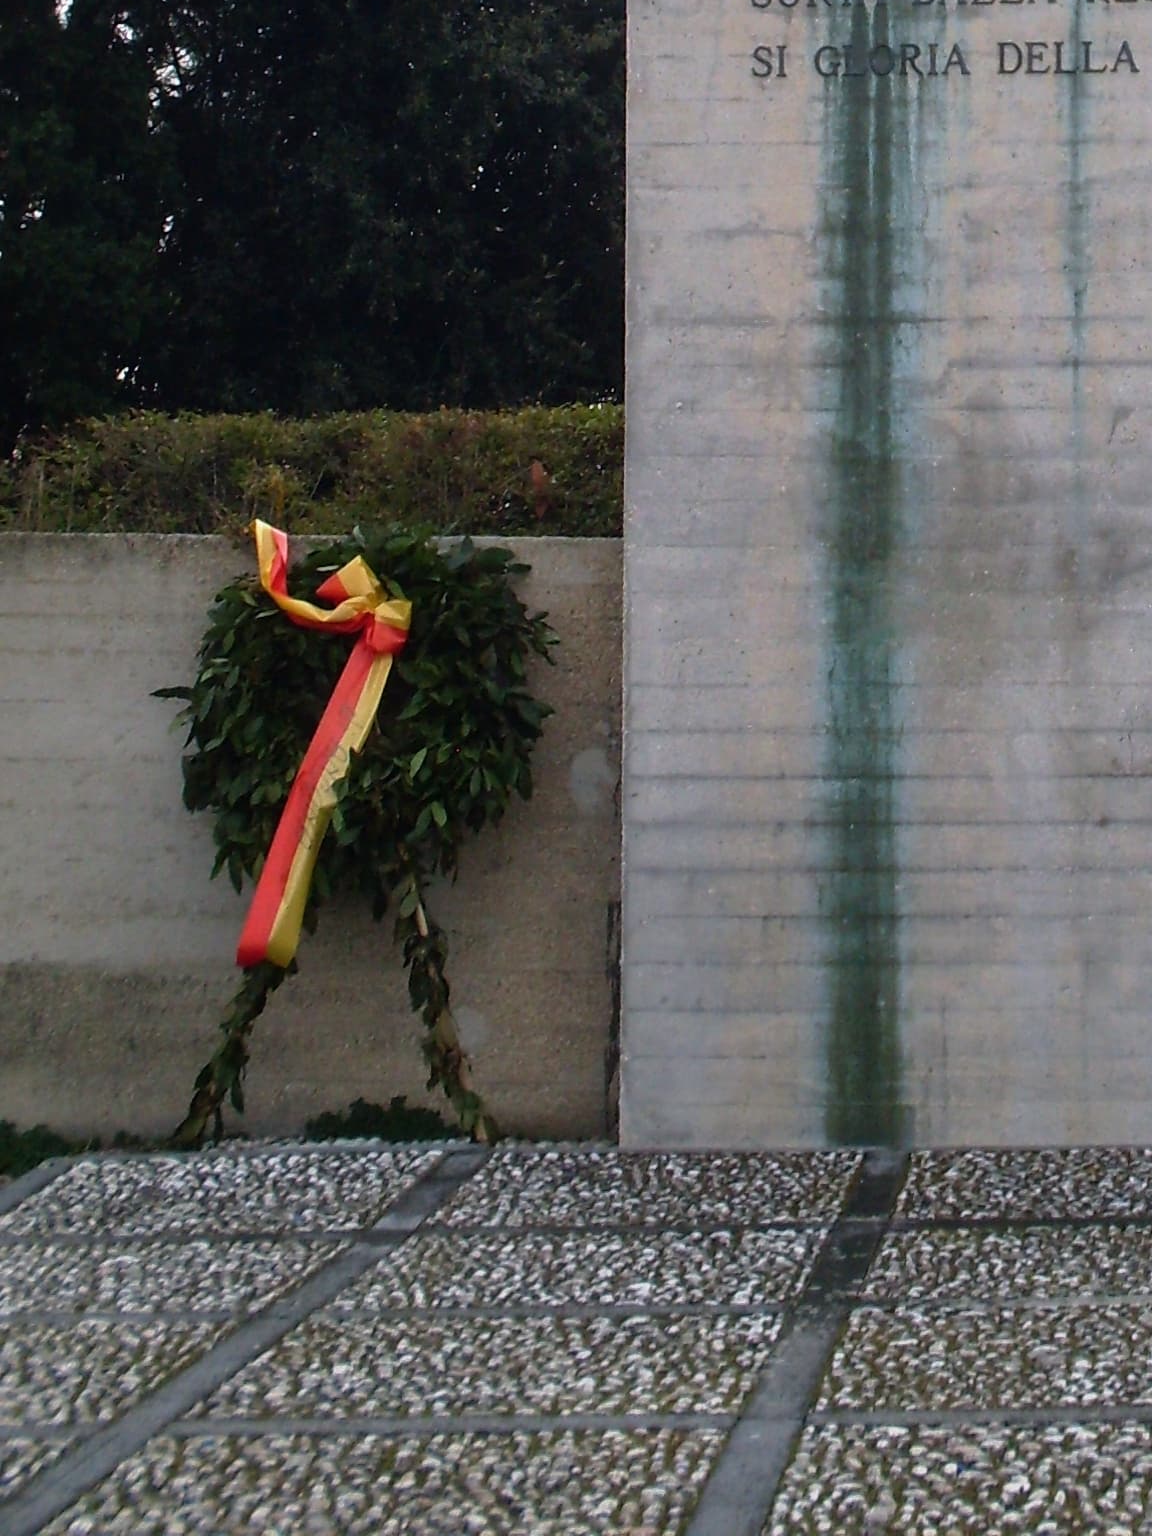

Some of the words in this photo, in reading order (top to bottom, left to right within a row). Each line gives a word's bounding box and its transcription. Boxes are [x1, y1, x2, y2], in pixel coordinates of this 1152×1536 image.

[751, 45, 787, 78] SI
[814, 43, 970, 77] GLORIA
[998, 40, 1140, 75] DELLA
